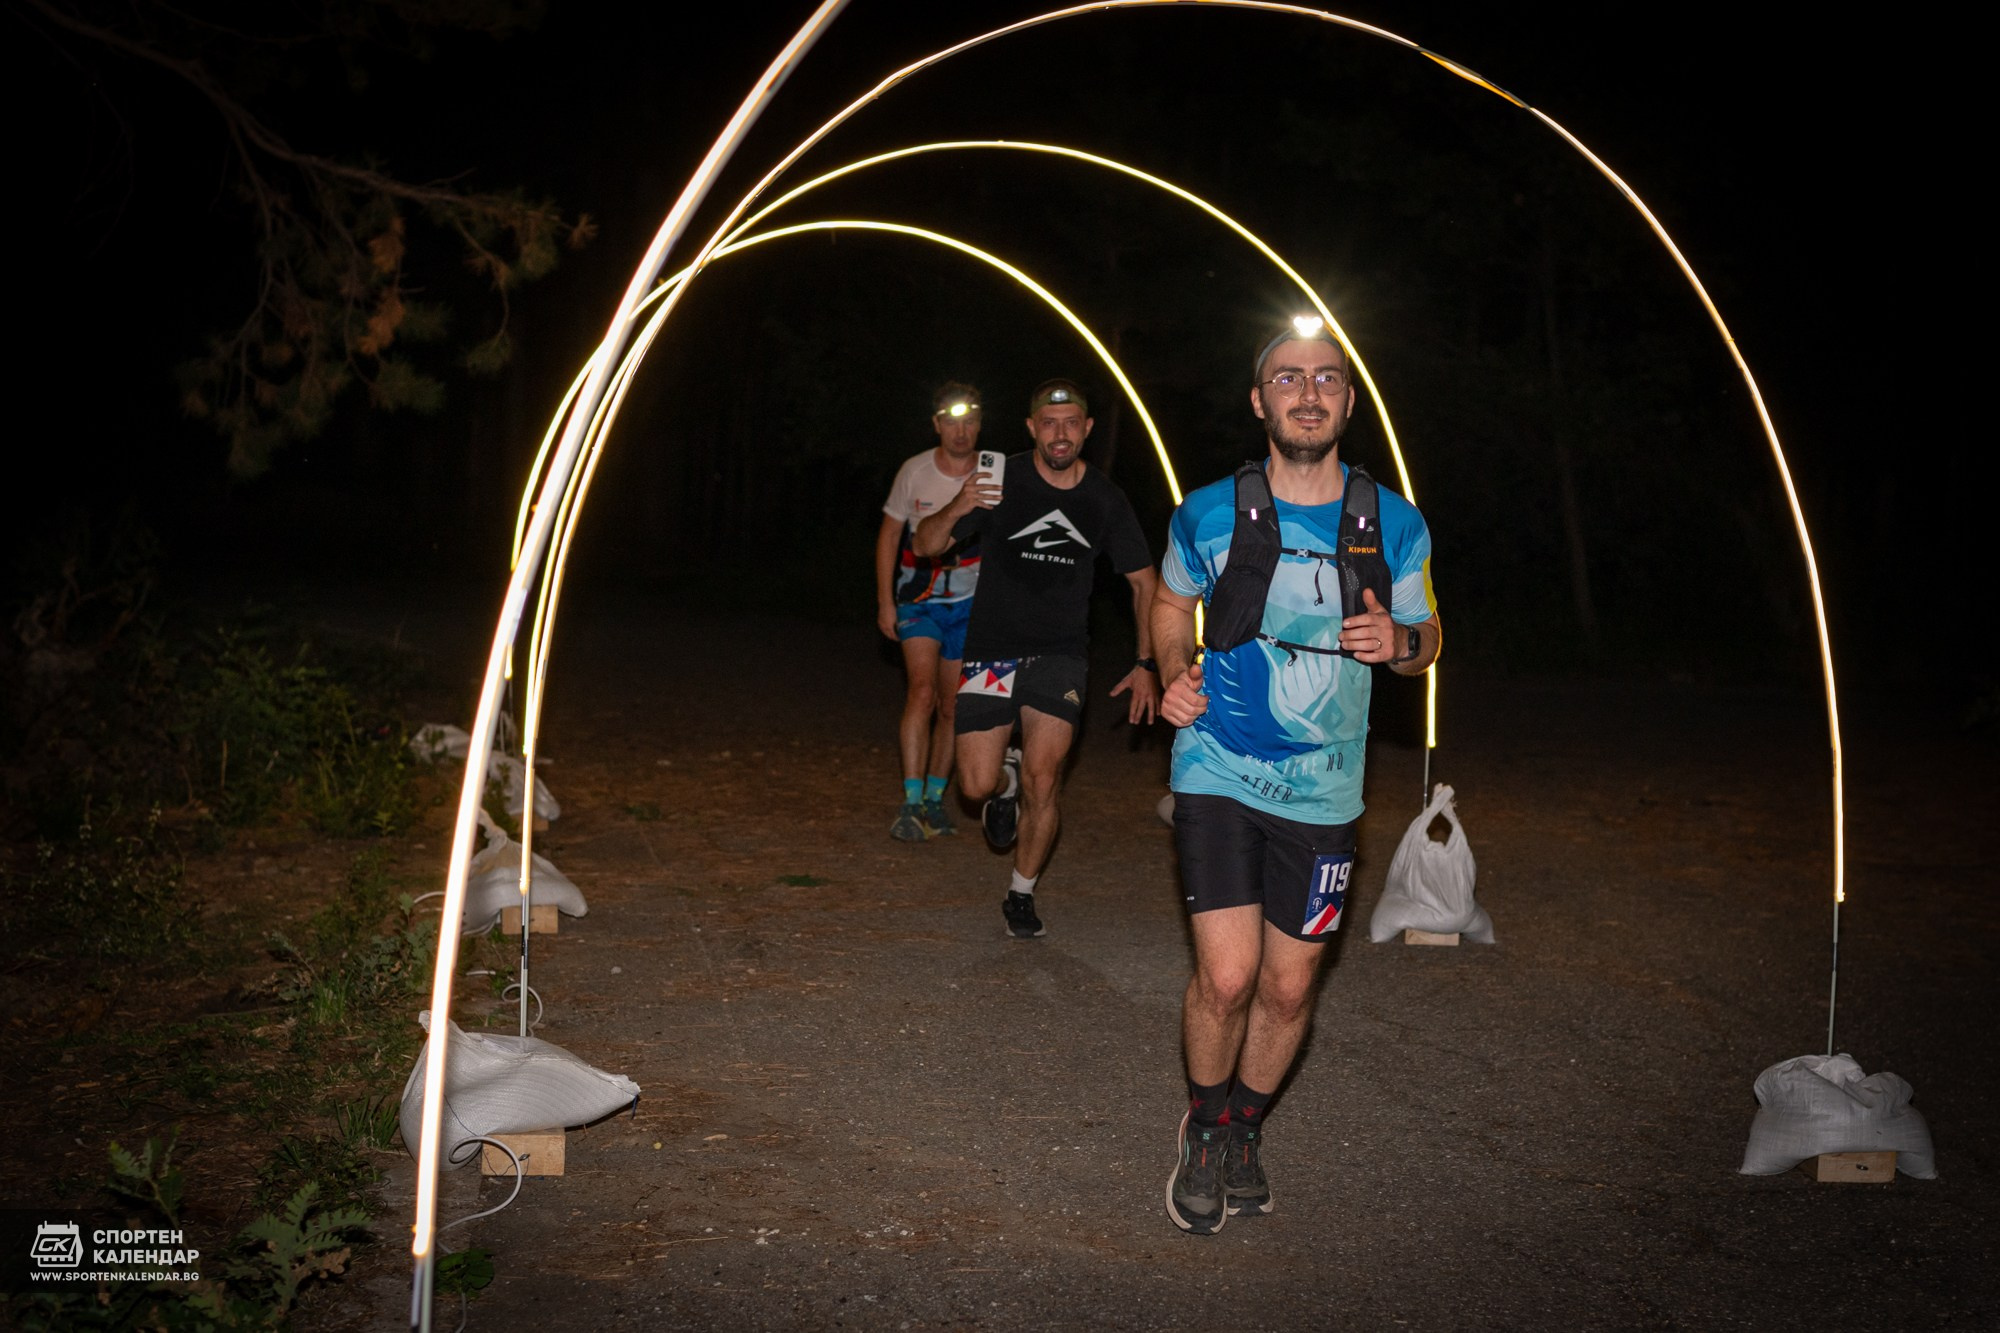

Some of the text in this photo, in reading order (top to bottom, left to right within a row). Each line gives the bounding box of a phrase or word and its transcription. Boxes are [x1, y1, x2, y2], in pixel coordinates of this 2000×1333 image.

[1348, 546, 1377, 554] KIPRUN
[1021, 551, 1076, 565] NIKE TRAIL
[1319, 862, 1351, 893] 119
